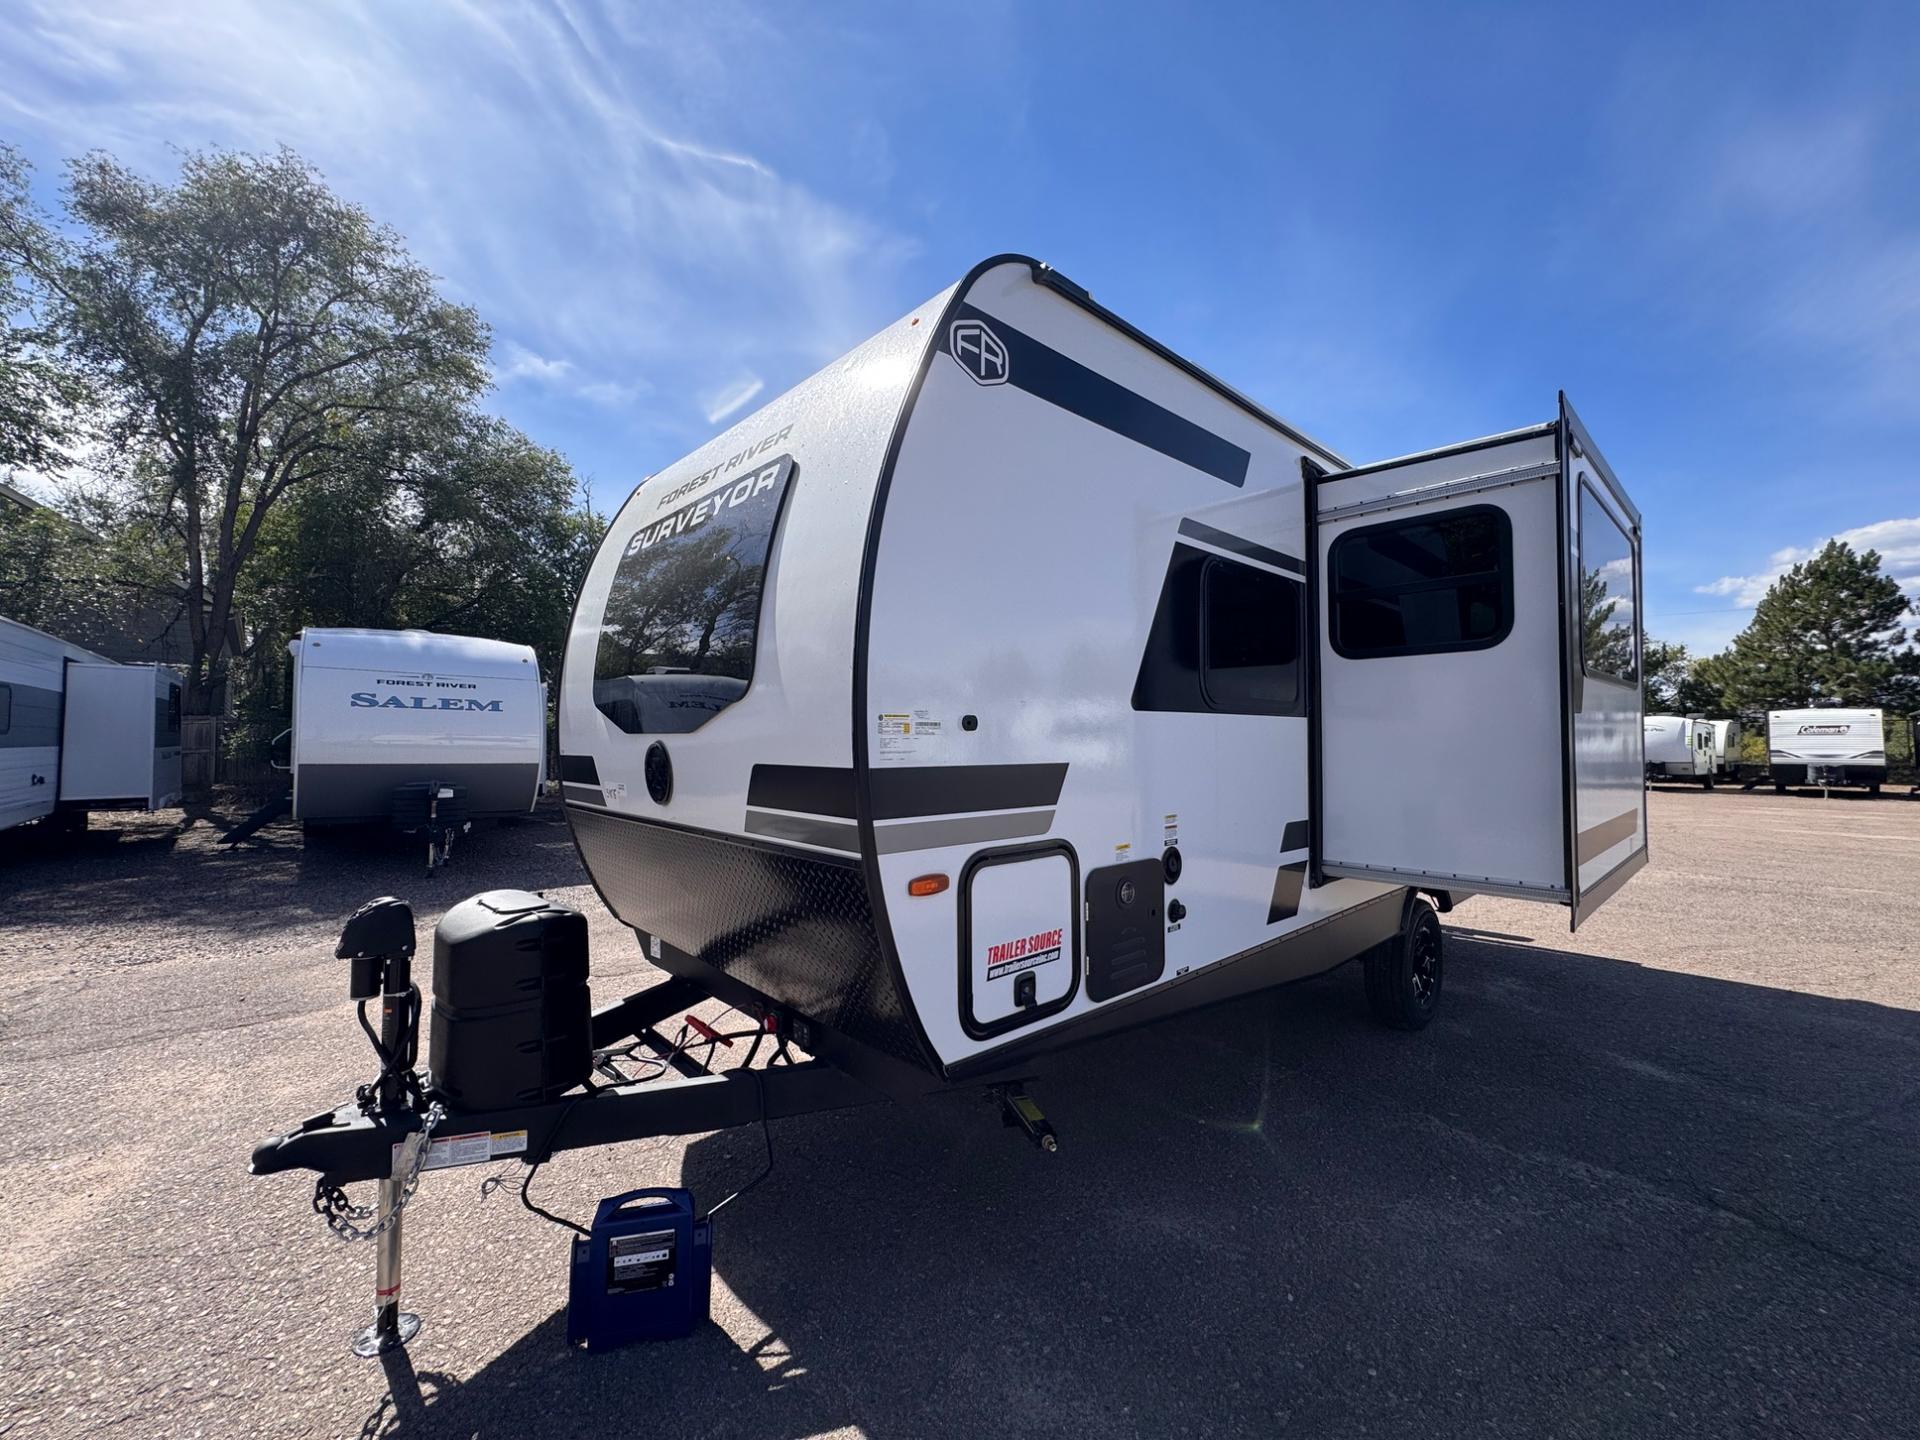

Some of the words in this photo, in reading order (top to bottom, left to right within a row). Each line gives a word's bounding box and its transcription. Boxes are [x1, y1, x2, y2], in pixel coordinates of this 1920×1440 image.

[657, 464, 725, 510] FOREST
[725, 424, 794, 472] RIVER
[627, 463, 781, 556] SURVEYOR
[376, 678, 433, 688] FOREST
[436, 681, 477, 690] RIVER
[350, 692, 504, 713] SALEM
[1800, 725, 1838, 734] Coleman
[988, 938, 1027, 966] TRAILER
[1027, 928, 1062, 953] SOURCE
